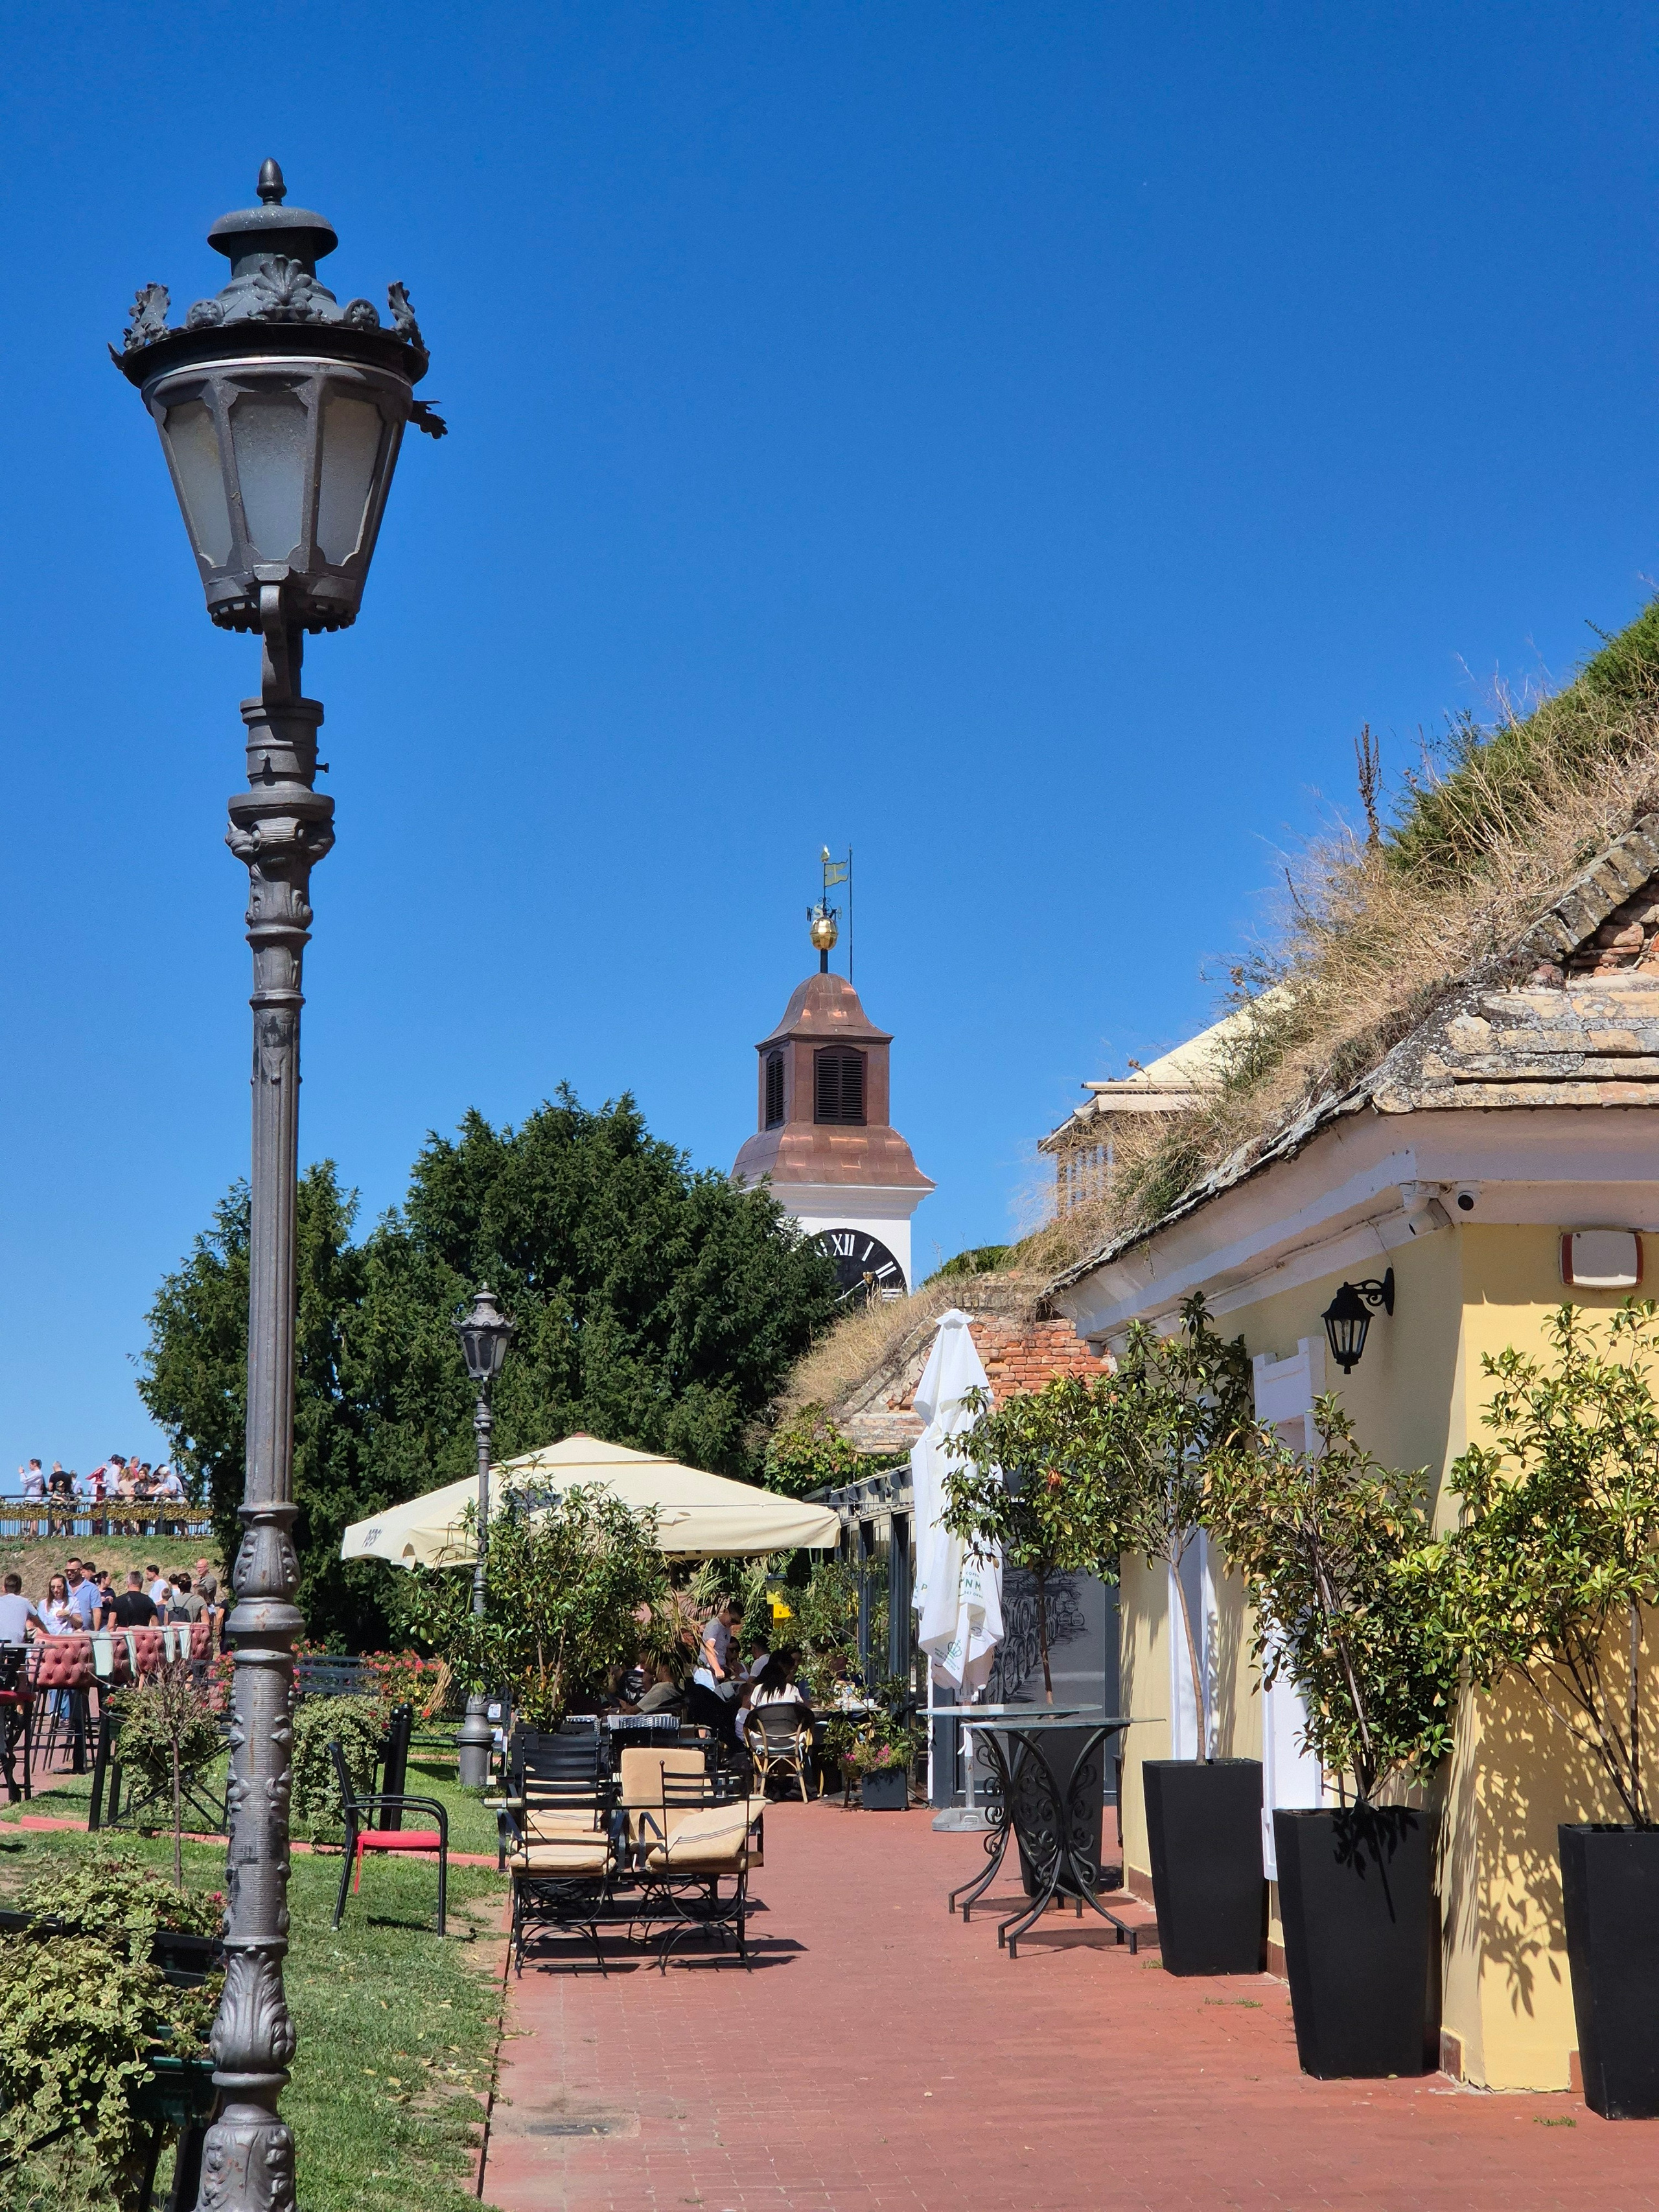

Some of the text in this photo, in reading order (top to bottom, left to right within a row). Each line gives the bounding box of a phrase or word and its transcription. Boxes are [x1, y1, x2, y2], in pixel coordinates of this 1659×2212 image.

[831, 1233, 855, 1256] XII
[861, 1240, 875, 1262] I
[875, 1261, 897, 1279] II
